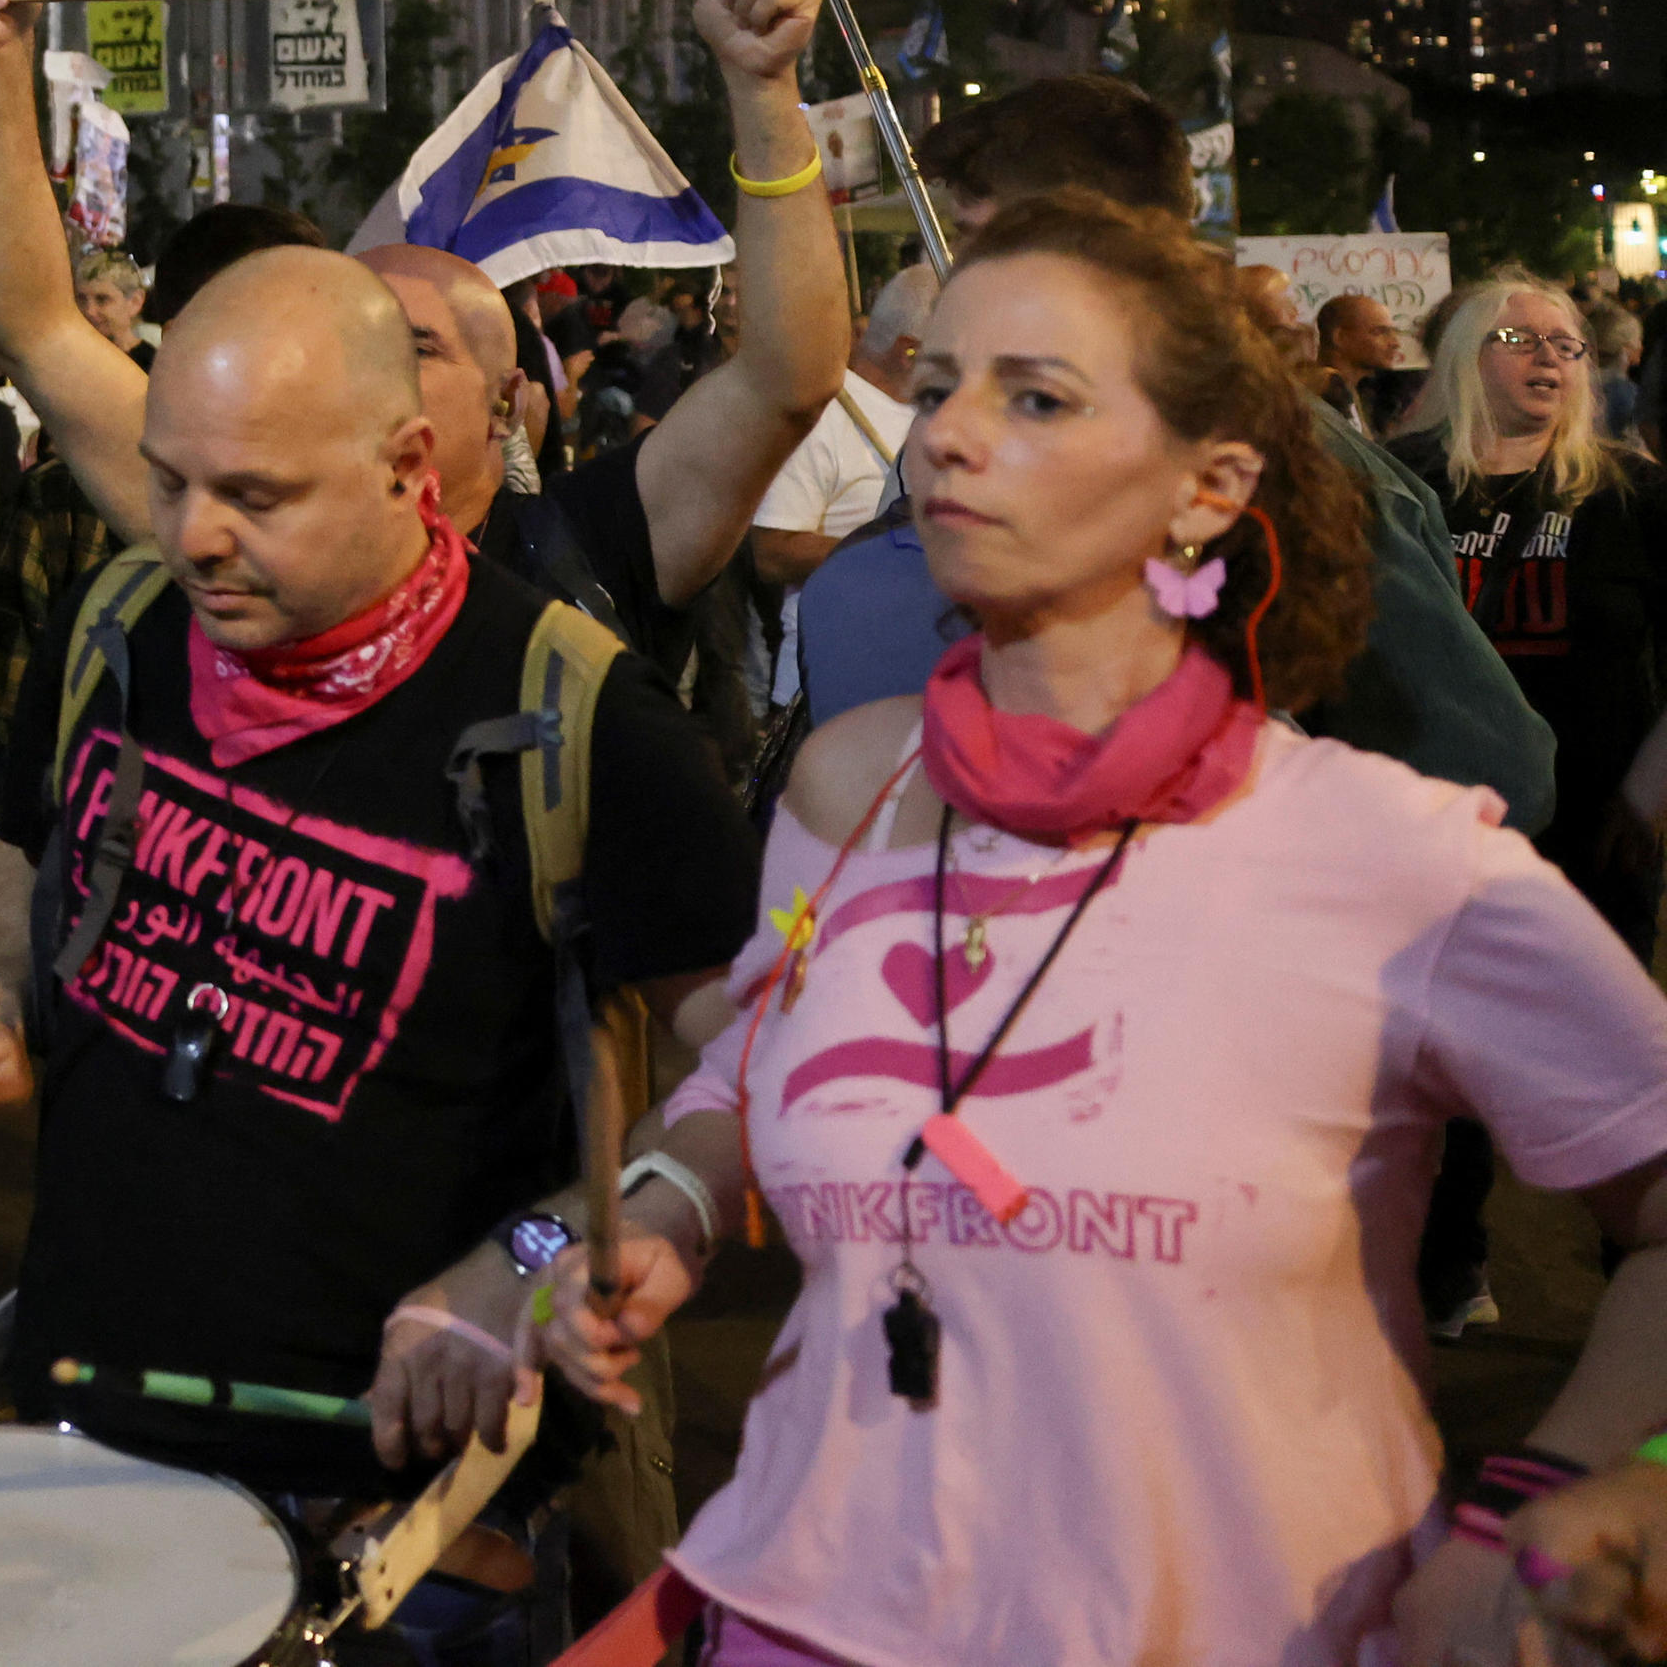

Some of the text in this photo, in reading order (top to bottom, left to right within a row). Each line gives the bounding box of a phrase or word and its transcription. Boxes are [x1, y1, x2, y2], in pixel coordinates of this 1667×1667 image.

[276, 36, 344, 63] אשם
[78, 768, 397, 968] PNKFRONT
[771, 1181, 1199, 1265] NKFRONT
